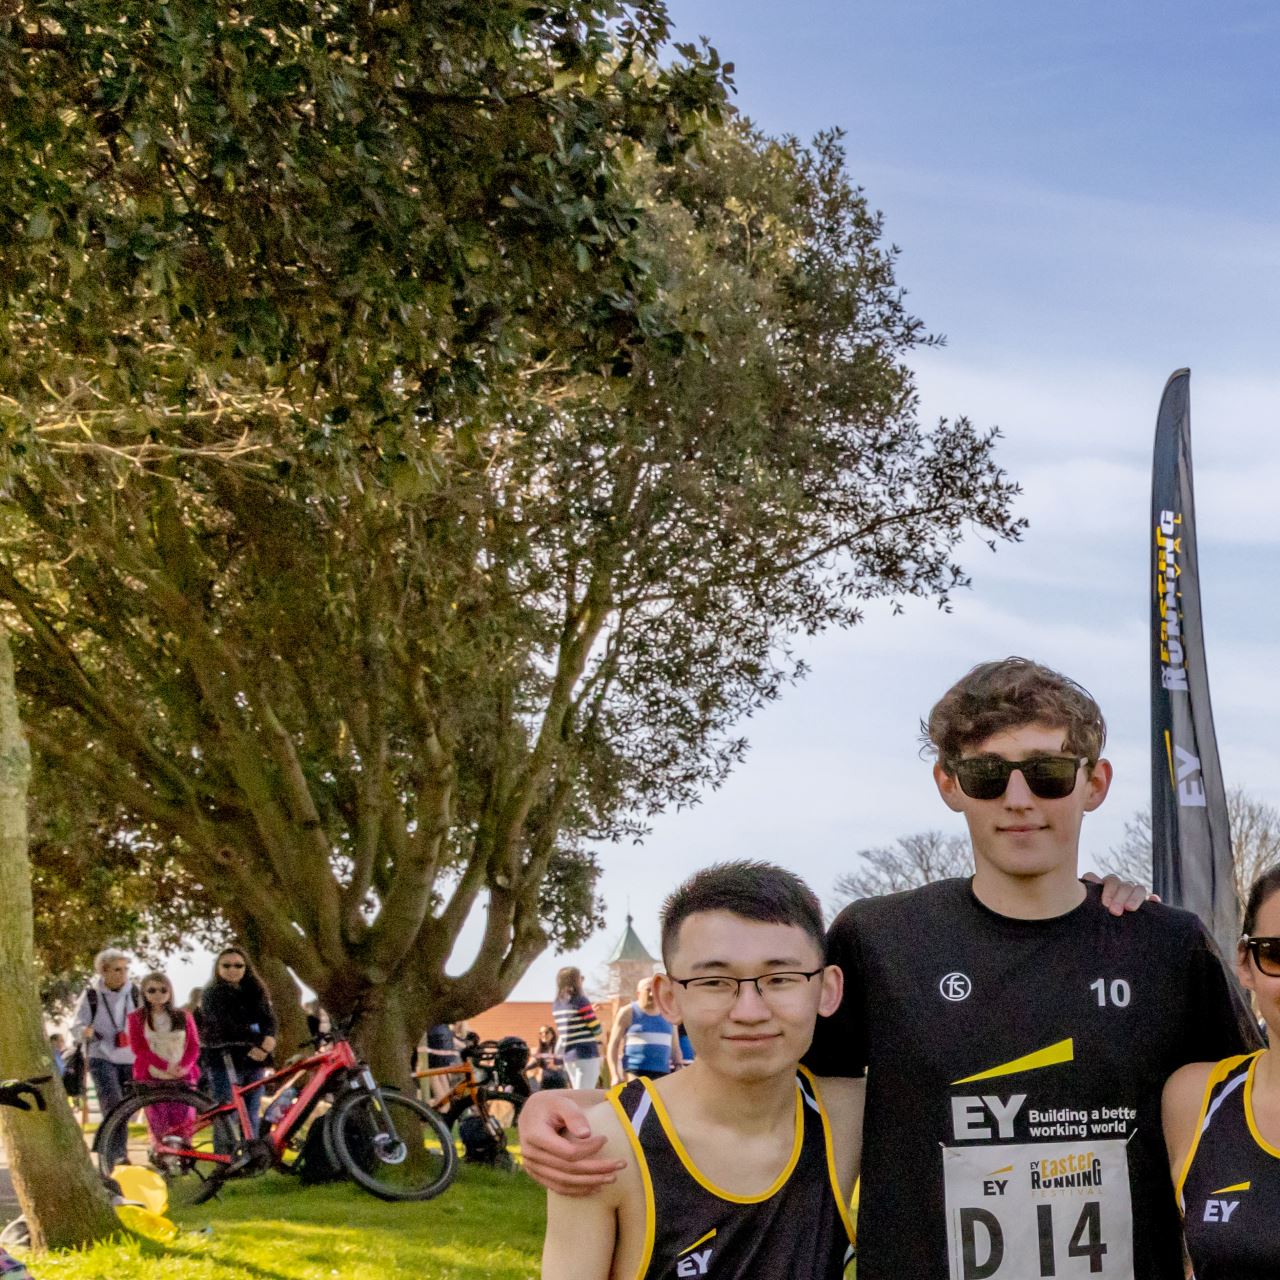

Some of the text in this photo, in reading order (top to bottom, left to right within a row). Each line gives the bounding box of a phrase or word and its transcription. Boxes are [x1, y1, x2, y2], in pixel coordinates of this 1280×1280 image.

[1175, 744, 1206, 806] EY
[1090, 978, 1131, 1008] 10
[951, 1094, 1028, 1140] EY
[1029, 1107, 1137, 1123] Building a bette
[1029, 1120, 1127, 1137] working world
[1030, 1151, 1094, 1179] EY Easter
[1031, 1158, 1102, 1190] RUNNING
[983, 1180, 1009, 1196] EY
[1031, 1188, 1103, 1198] FESTIVAL
[1203, 1200, 1240, 1222] EY
[960, 1207, 1004, 1280] D
[1037, 1201, 1107, 1277] 14
[677, 1249, 713, 1278] EY
